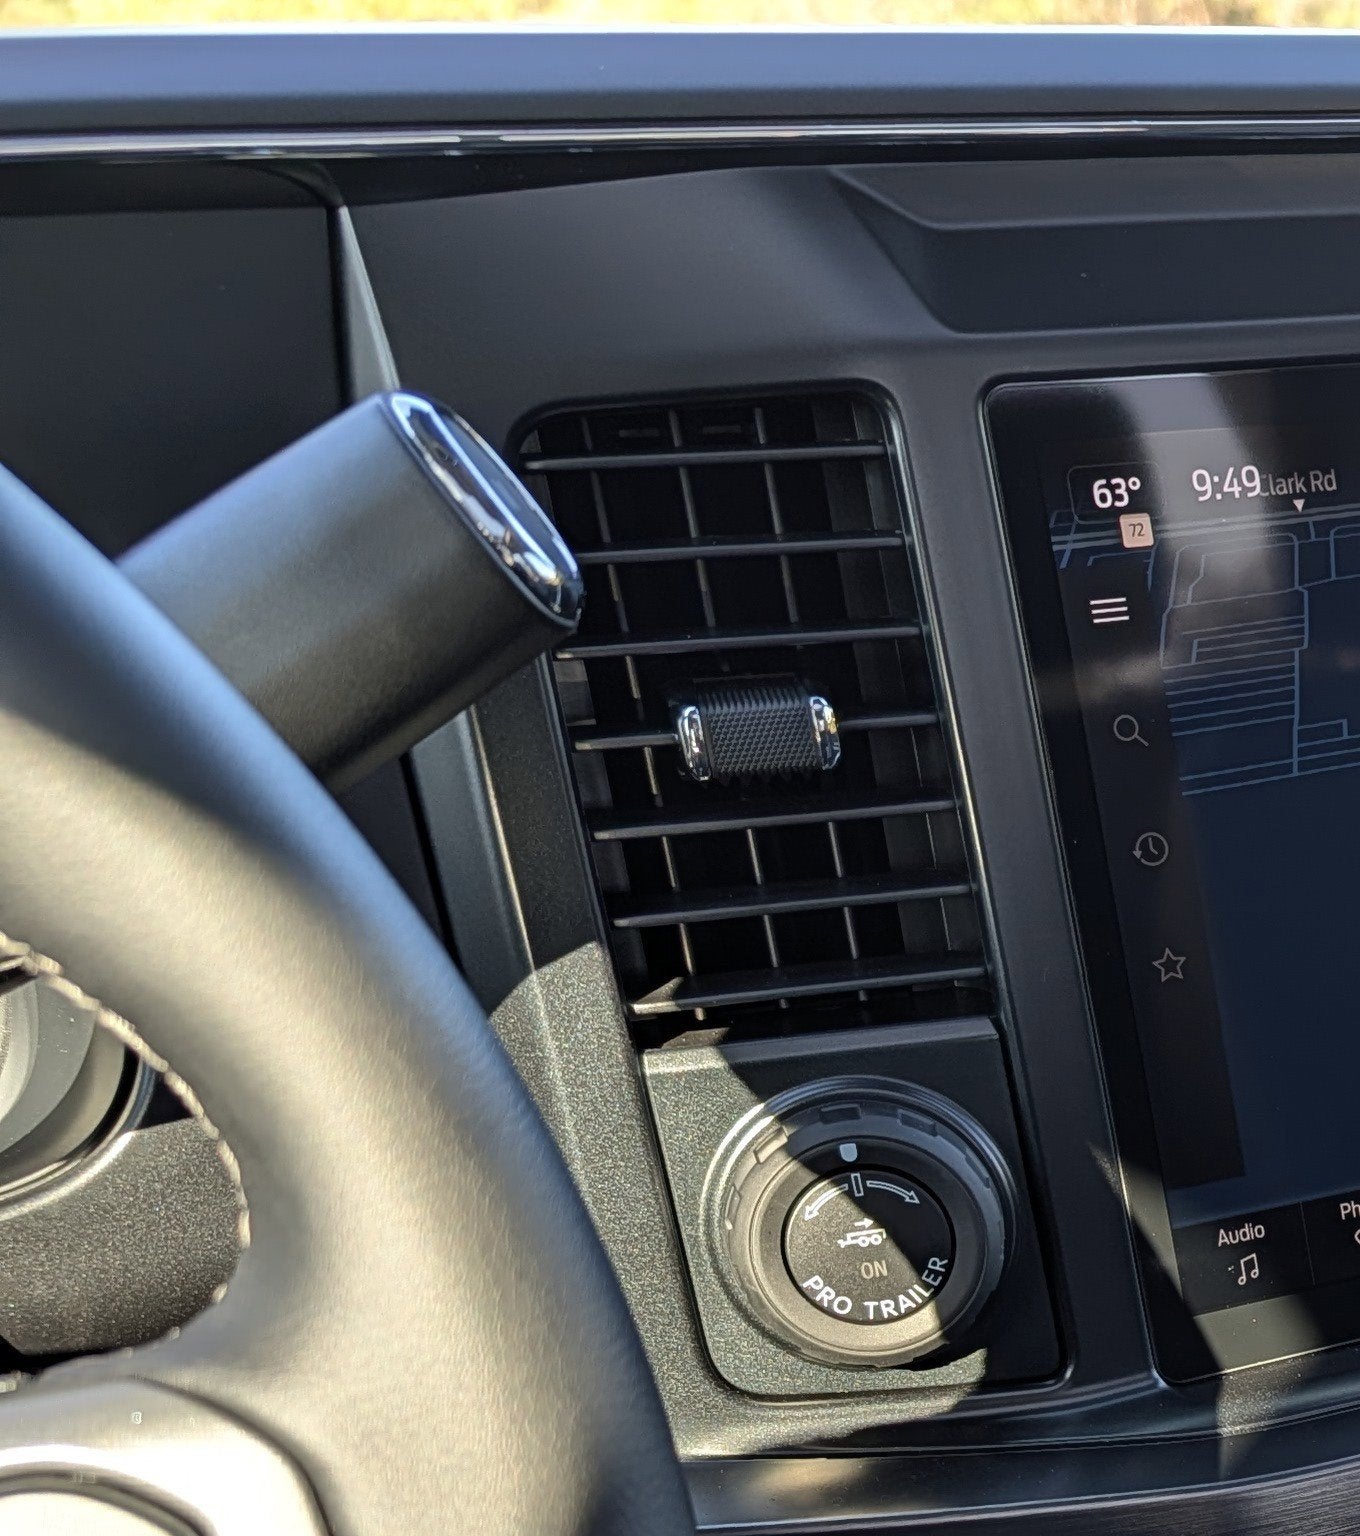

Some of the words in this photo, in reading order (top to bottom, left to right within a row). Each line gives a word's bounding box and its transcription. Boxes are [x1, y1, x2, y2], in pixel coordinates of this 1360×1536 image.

[1191, 465, 1262, 501] 9:49
[1310, 468, 1337, 492] Rd
[1128, 522, 1145, 538] 72
[1217, 1221, 1265, 1247] Audio
[860, 1260, 888, 1280] ON
[801, 1275, 852, 1315] PRO
[863, 1256, 949, 1320] TRAILER
